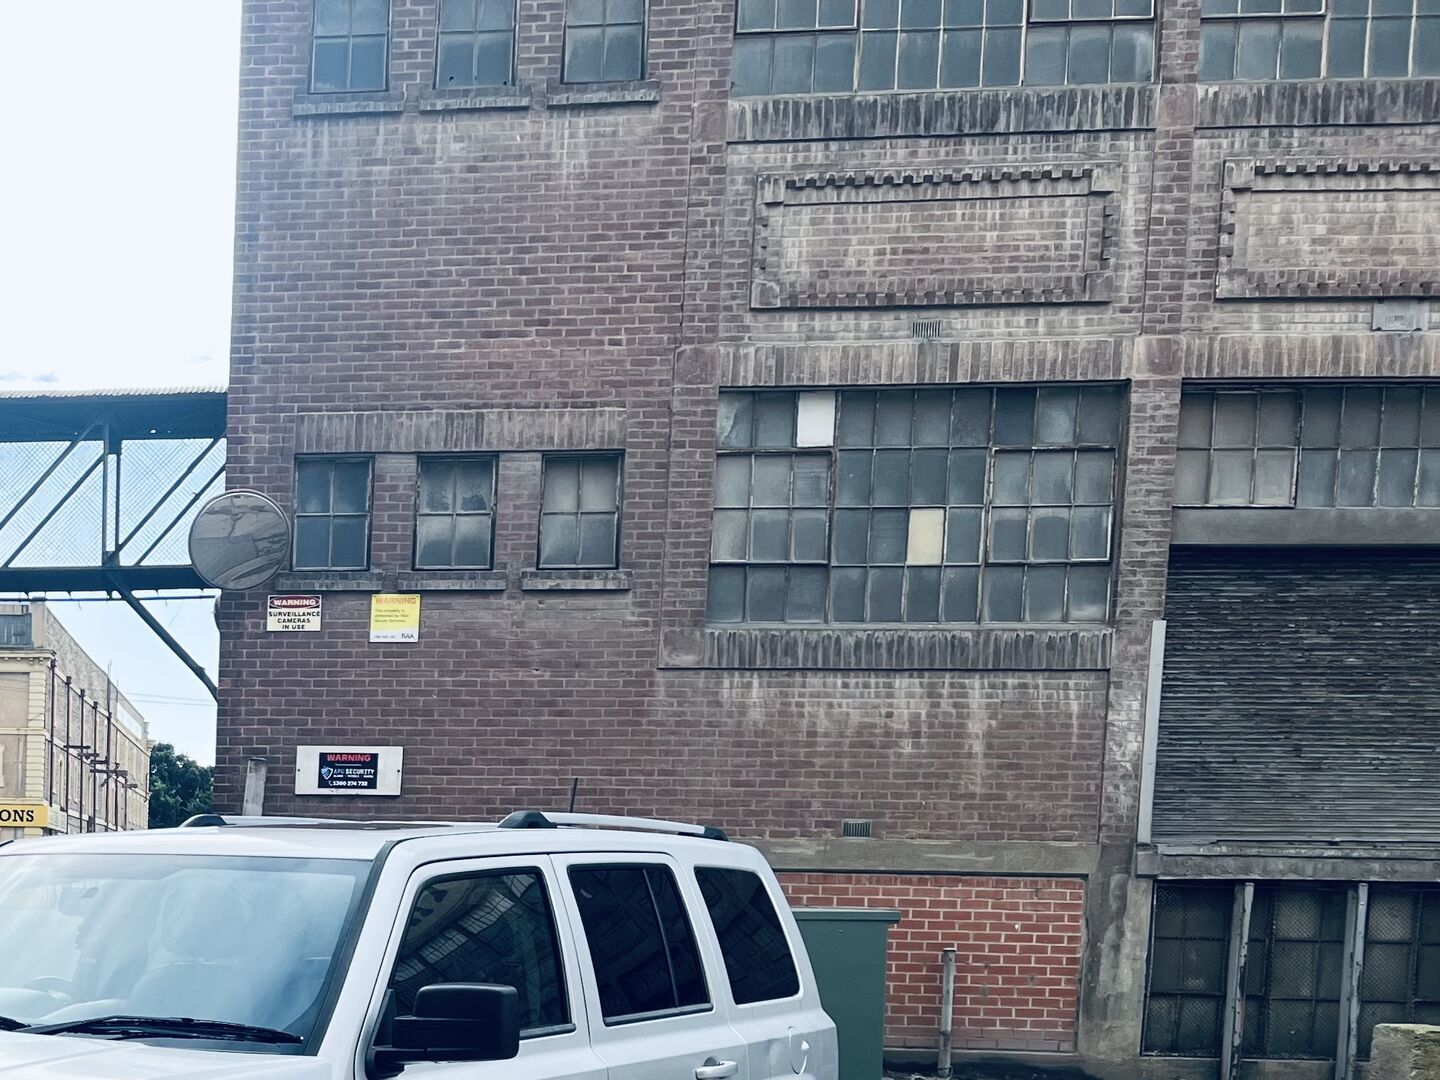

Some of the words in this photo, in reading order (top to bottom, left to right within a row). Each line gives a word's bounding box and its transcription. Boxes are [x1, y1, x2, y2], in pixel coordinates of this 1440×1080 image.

[273, 598, 316, 606] WARNING
[376, 597, 416, 605] WARNING
[327, 754, 371, 762] WARNING
